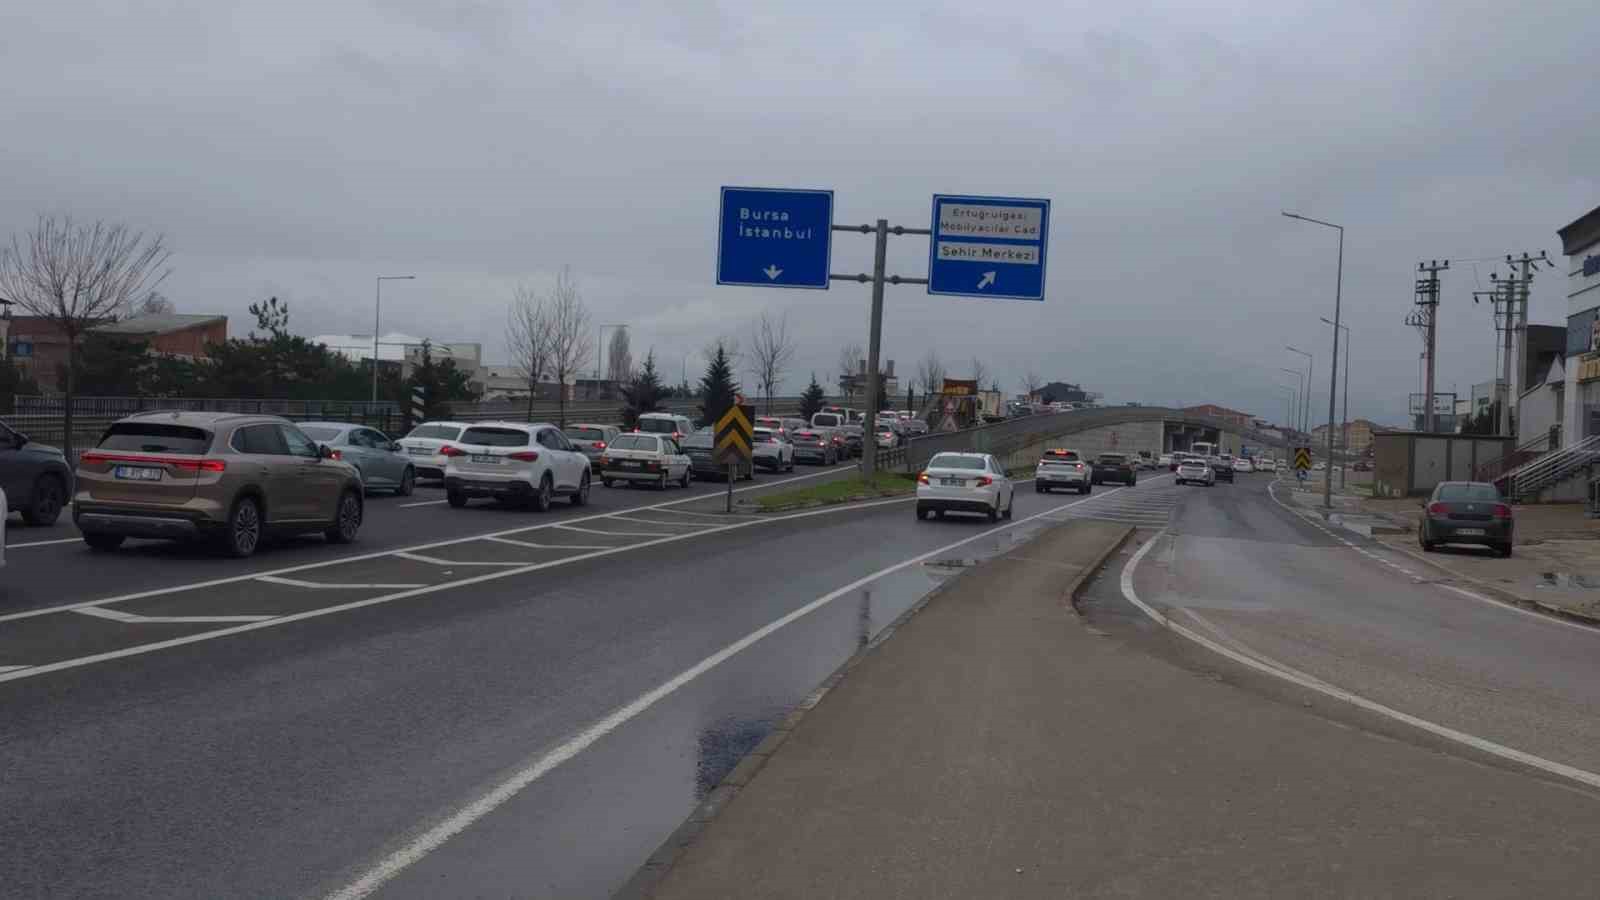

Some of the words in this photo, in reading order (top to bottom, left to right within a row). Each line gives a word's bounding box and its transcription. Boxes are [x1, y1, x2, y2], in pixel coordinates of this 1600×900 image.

[740, 207, 789, 221] Bursa
[739, 221, 812, 240] İstanbul
[982, 247, 1035, 261] Merkezi
